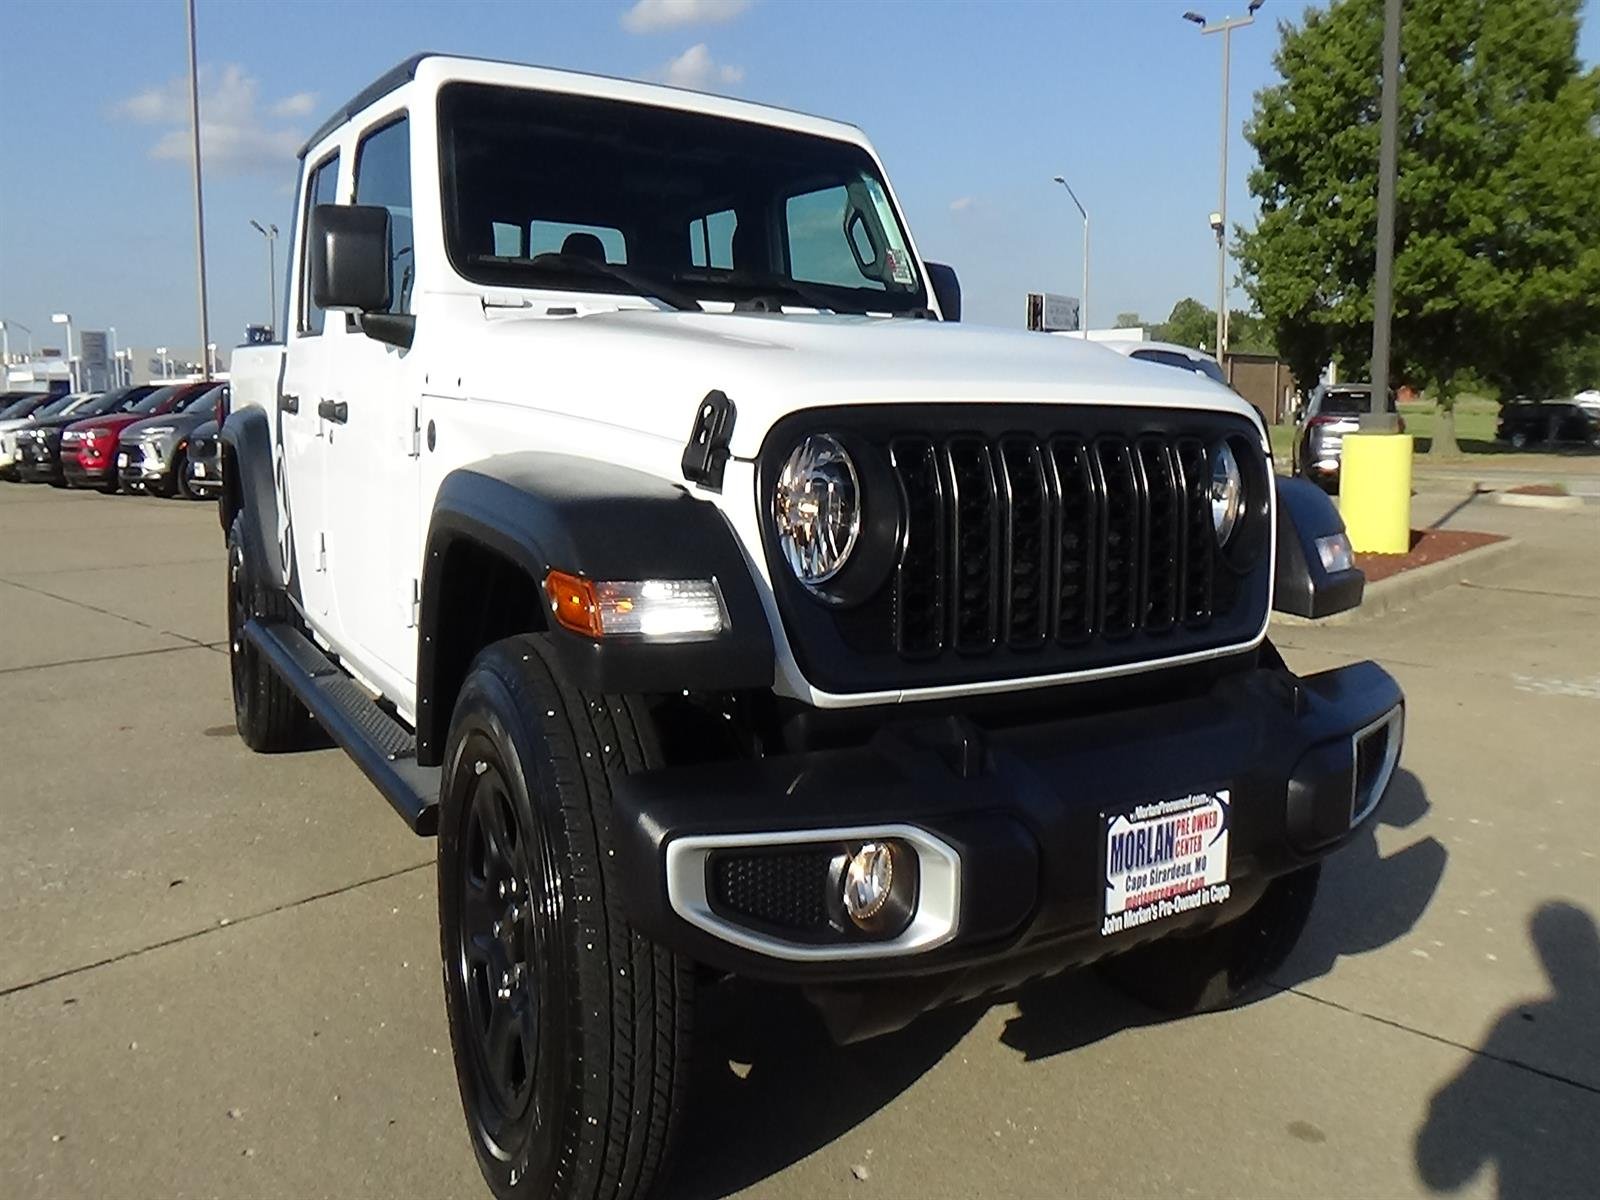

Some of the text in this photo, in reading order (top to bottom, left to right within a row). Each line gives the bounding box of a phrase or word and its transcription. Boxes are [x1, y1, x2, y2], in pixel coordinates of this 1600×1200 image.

[1176, 810, 1218, 838] PRE OWNED
[1110, 821, 1175, 874] MORLAN
[1175, 835, 1203, 858] CENTER
[1125, 873, 1148, 893] Cape
[1194, 855, 1207, 874] MO
[1101, 884, 1231, 936] John Morlan's Pre-Owned in Cape
